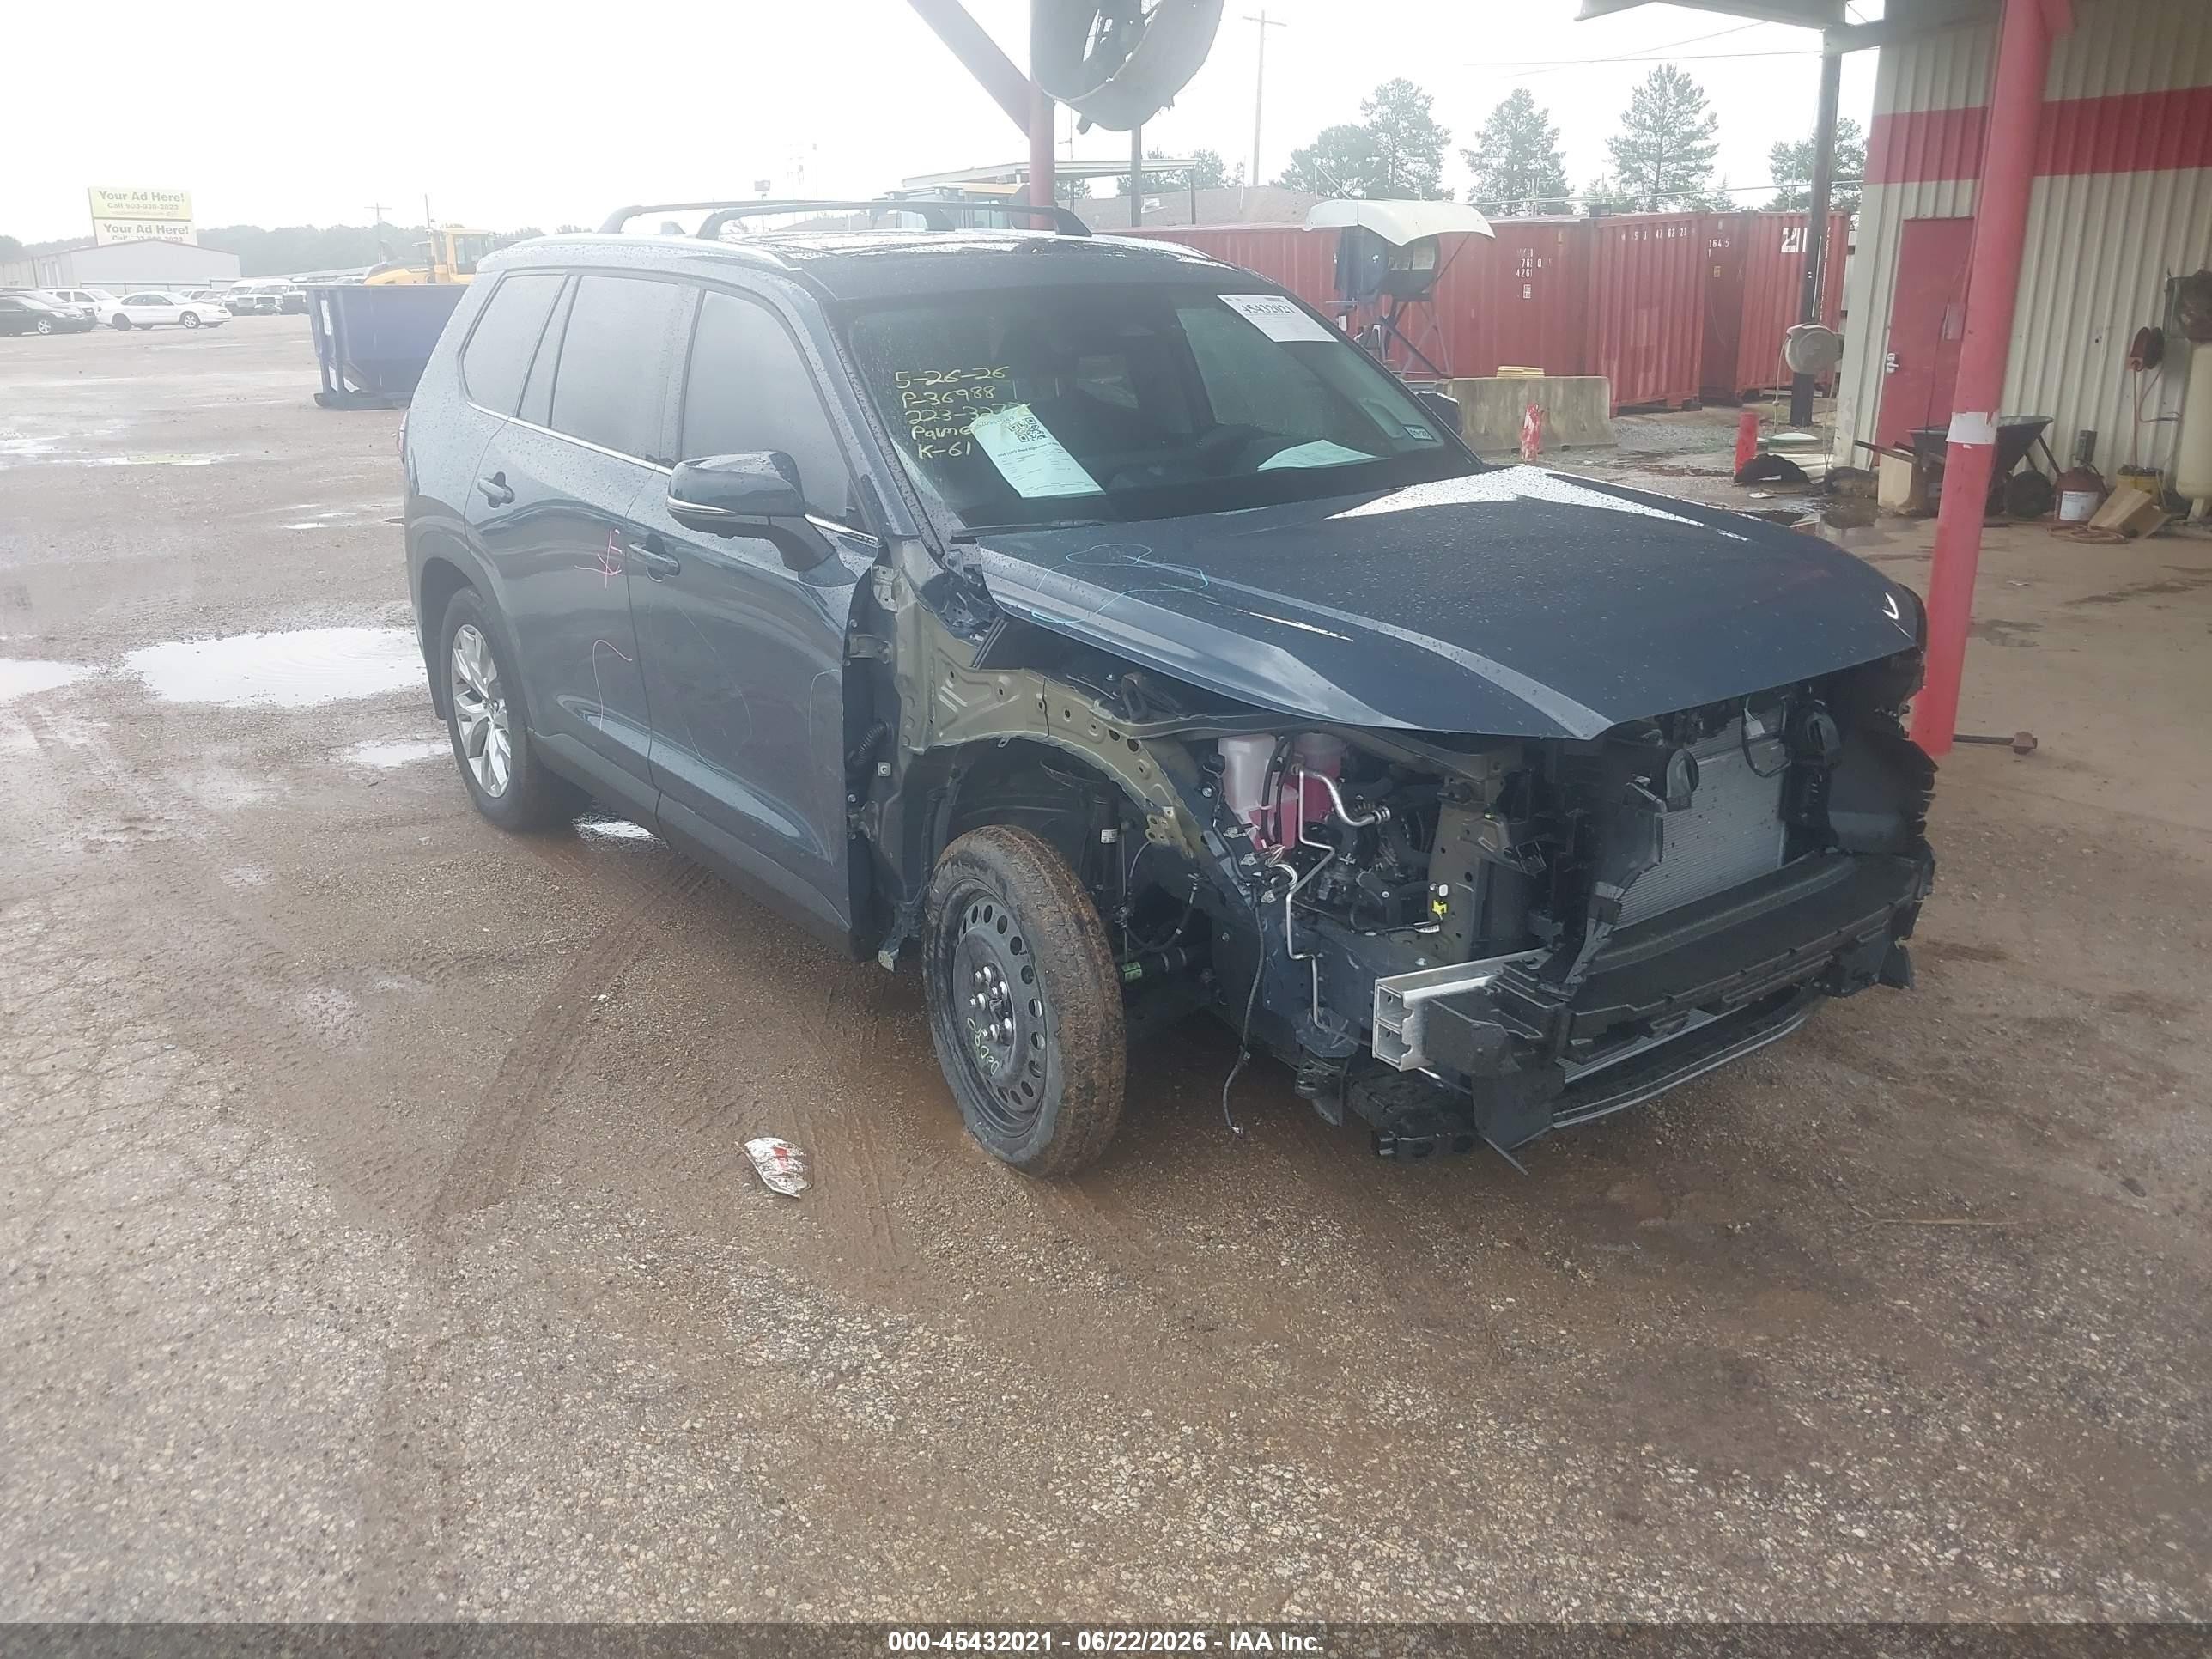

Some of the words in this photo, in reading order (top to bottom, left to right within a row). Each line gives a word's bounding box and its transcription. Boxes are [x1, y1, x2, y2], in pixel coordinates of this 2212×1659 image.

[99, 191, 128, 200] Your
[131, 191, 148, 201] Ad
[151, 192, 185, 202] Here!
[104, 223, 132, 234] Your
[136, 224, 153, 234] Ad
[156, 224, 189, 234] Here!
[895, 366, 1010, 389] 5-26-26
[902, 386, 996, 408] P-36988
[918, 441, 971, 459] K-61
